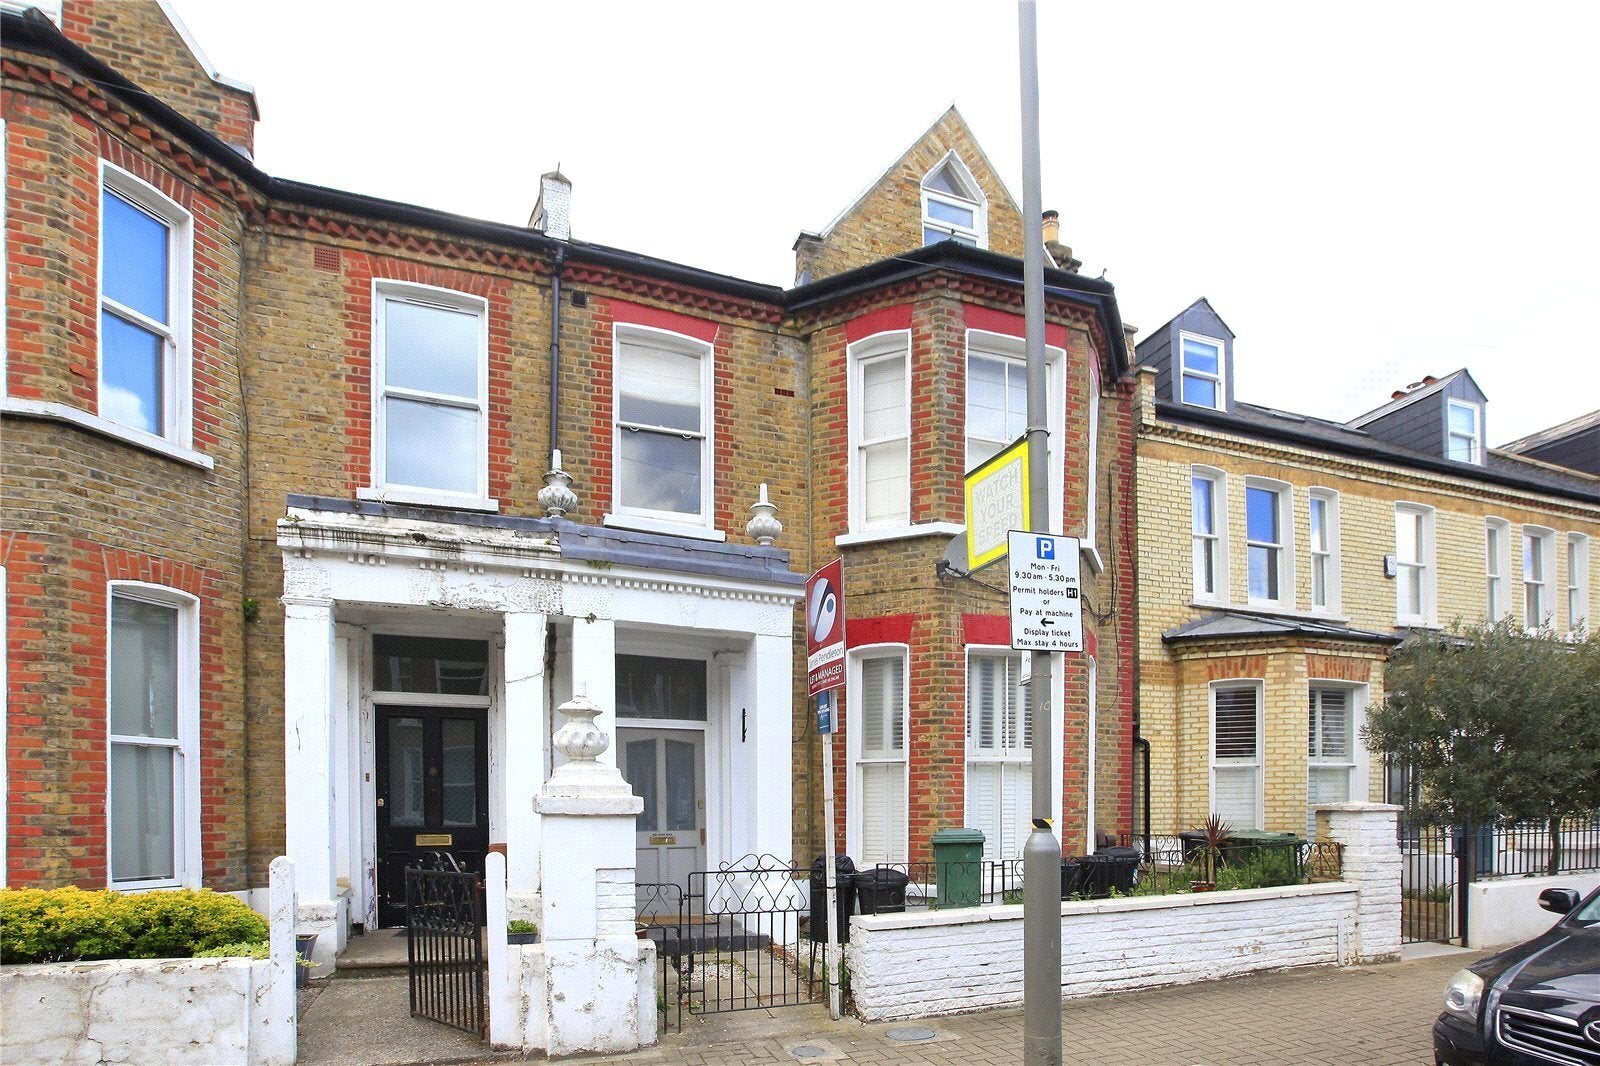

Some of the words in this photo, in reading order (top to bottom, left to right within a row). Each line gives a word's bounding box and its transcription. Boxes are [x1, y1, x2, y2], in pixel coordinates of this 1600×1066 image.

[976, 465, 1018, 503] WATCH
[981, 493, 1014, 524] YOUR
[977, 513, 1017, 545] SPEED
[1040, 540, 1053, 558] P
[1030, 562, 1046, 571] Mon
[1050, 564, 1060, 572] Fri
[1012, 585, 1036, 595] Permit
[1038, 588, 1064, 597] holders
[1066, 589, 1078, 598] H1
[1019, 607, 1033, 616] Pay
[1045, 610, 1074, 618] machine
[1023, 627, 1050, 637] Display
[1051, 629, 1071, 637] ticket
[1016, 638, 1032, 646] Max
[1034, 639, 1049, 648] stay
[1059, 640, 1079, 648] hours
